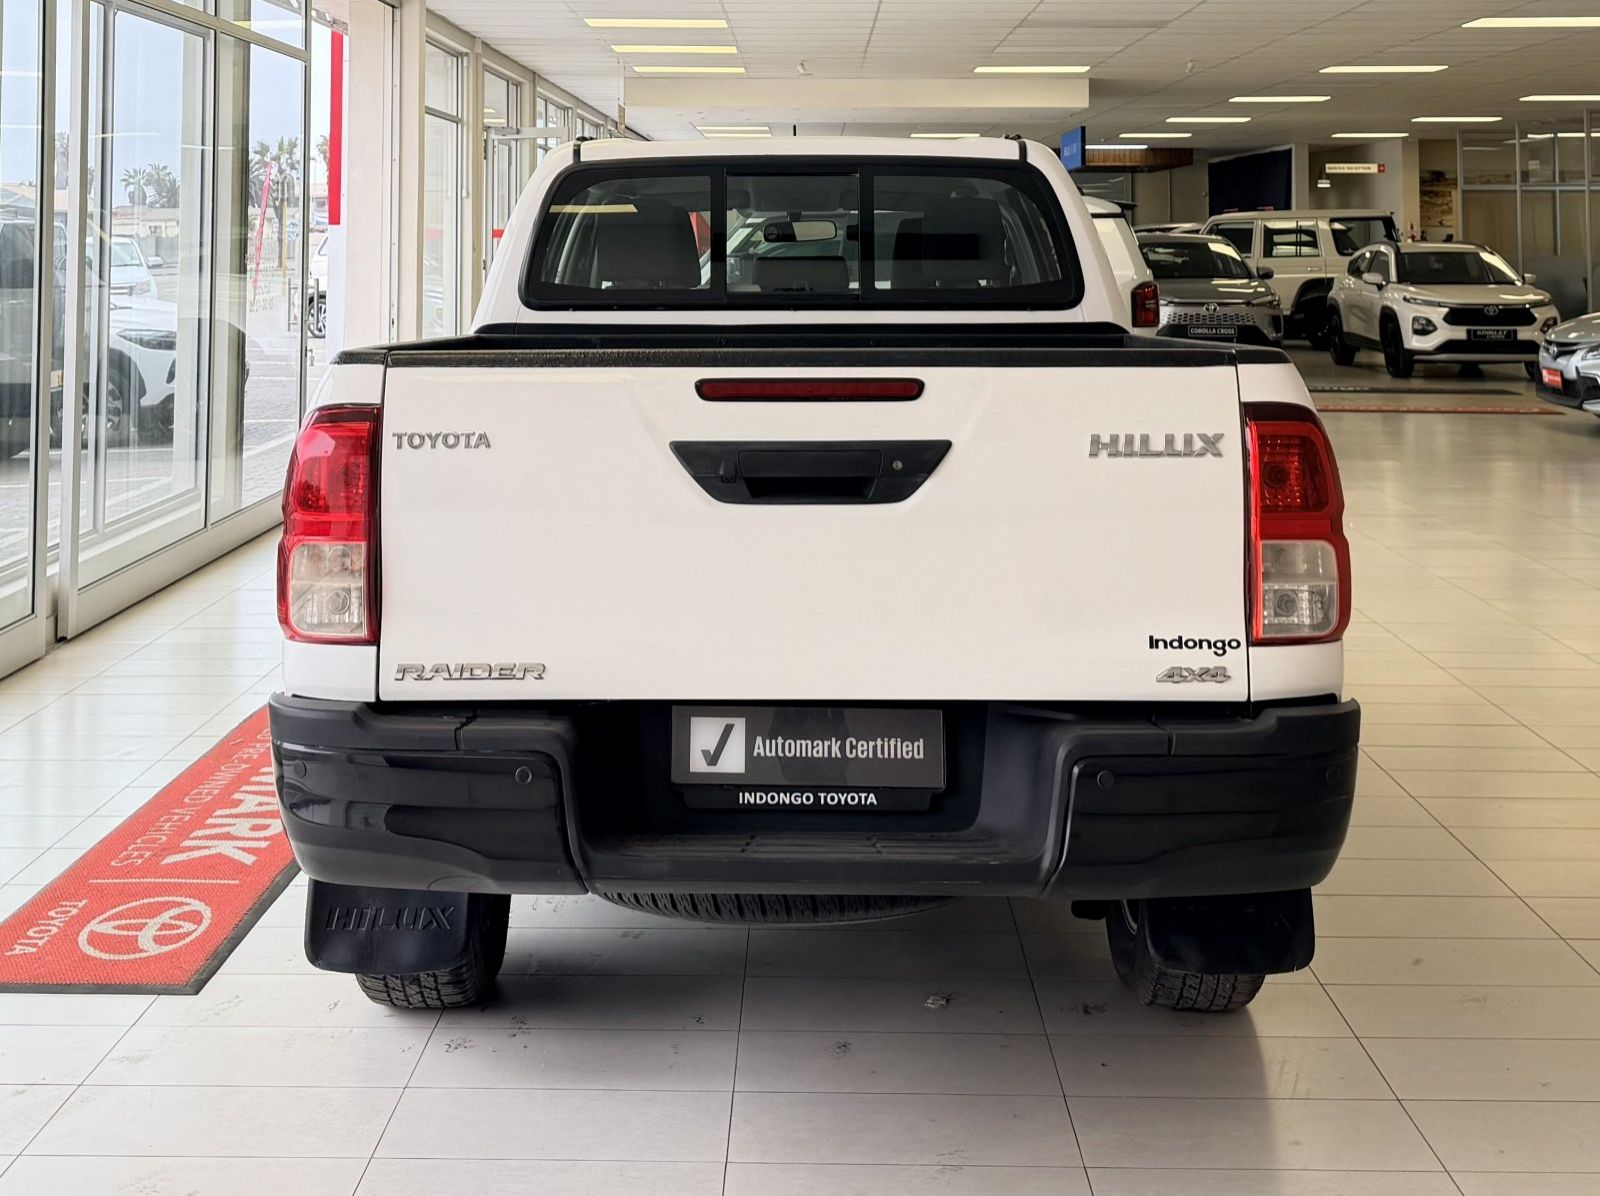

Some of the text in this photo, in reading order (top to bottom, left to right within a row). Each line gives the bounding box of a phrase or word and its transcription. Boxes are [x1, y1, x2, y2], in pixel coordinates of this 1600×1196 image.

[1190, 327, 1217, 335] COROLLA
[392, 432, 491, 449] TOYOTA
[1089, 433, 1224, 457] HILUX
[1149, 635, 1241, 657] Indongo
[394, 663, 546, 681] RAIDER
[753, 736, 924, 759] Automark Certified
[739, 792, 877, 806] INDONGO TOYOTA
[111, 806, 197, 866] VEHICLES
[5, 899, 88, 956] TOYOTA
[325, 905, 455, 931] HILUX
